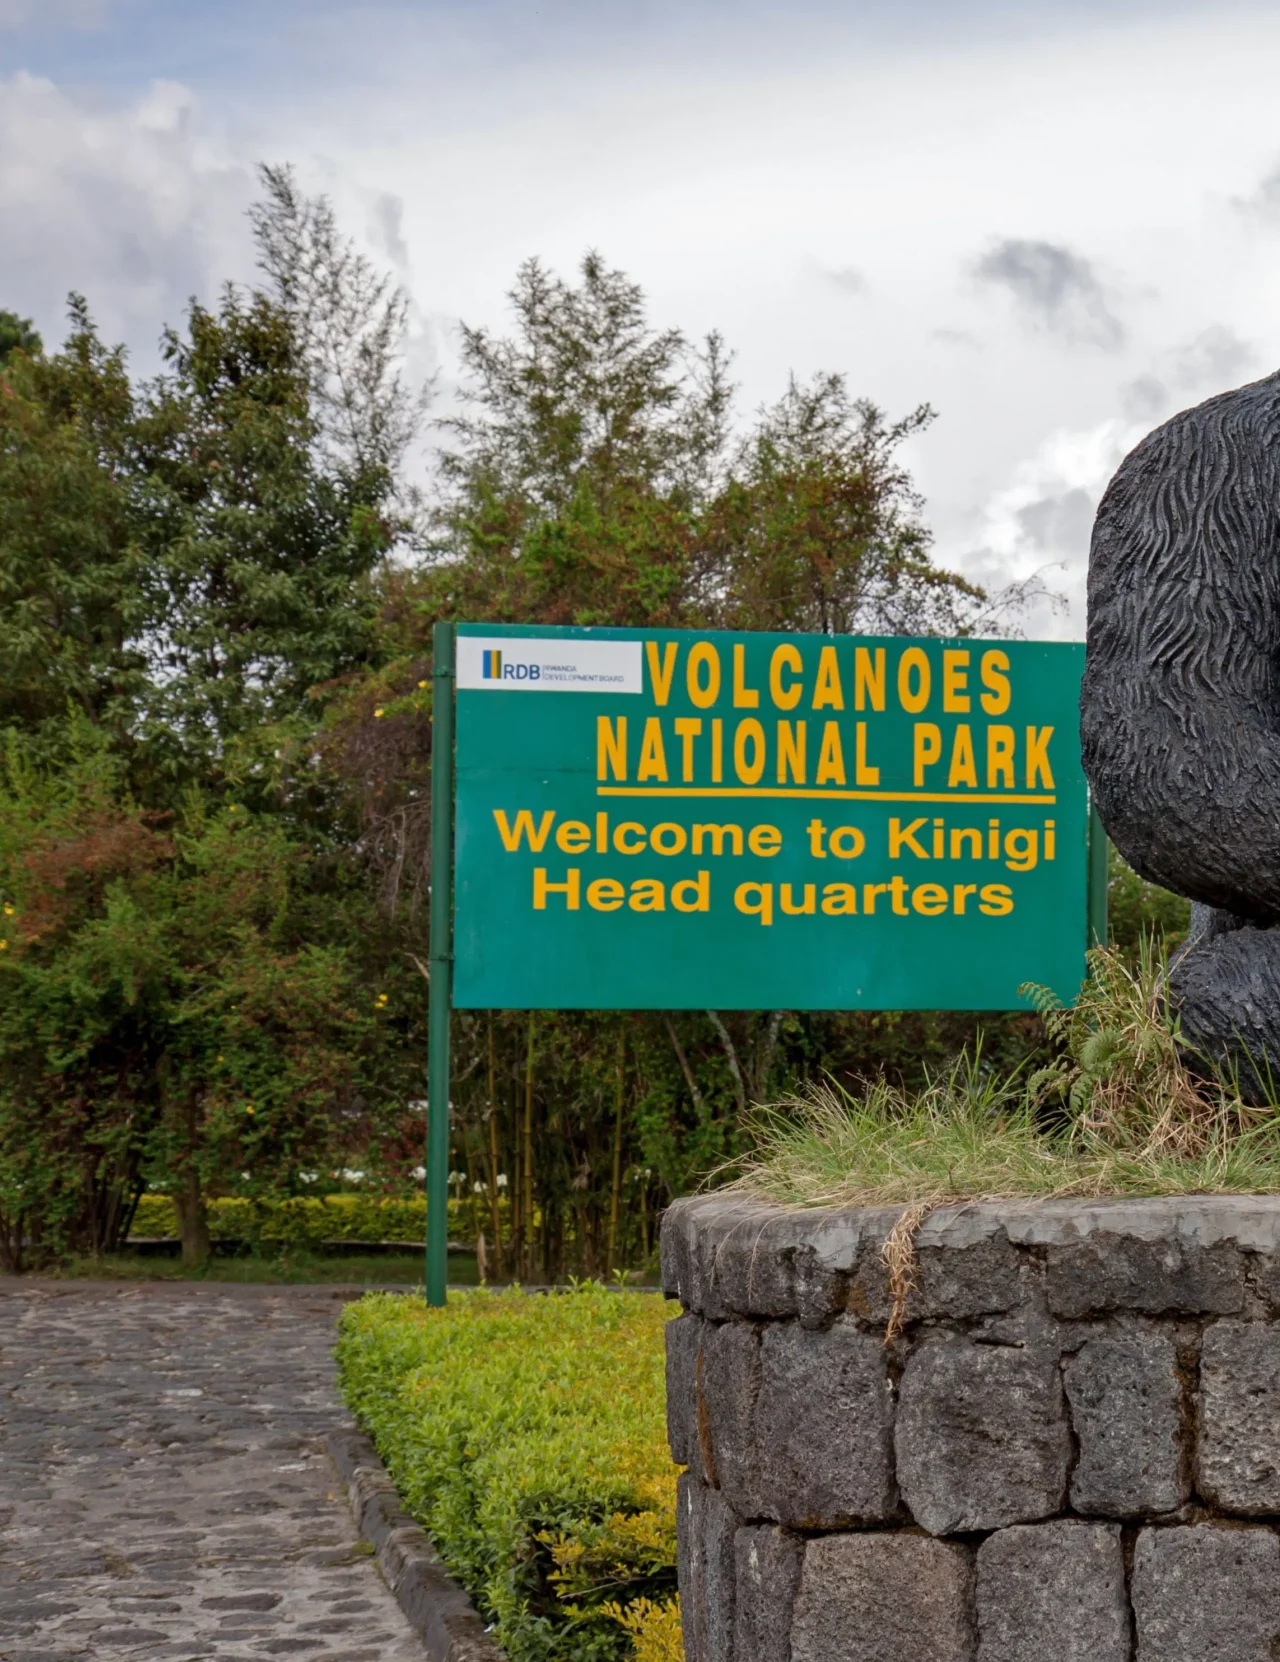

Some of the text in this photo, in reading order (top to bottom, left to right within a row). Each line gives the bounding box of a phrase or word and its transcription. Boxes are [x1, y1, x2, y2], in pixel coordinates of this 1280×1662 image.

[503, 664, 541, 680] RDB
[544, 665, 577, 673] RWANDA
[544, 673, 625, 683] DEVELOPMENT BOARD
[645, 640, 1012, 715] VOLCANOES
[596, 715, 1056, 790] NATIONAL PARK
[492, 808, 1056, 871] Welcome to Kinigi
[532, 866, 1015, 927] Head quarters
